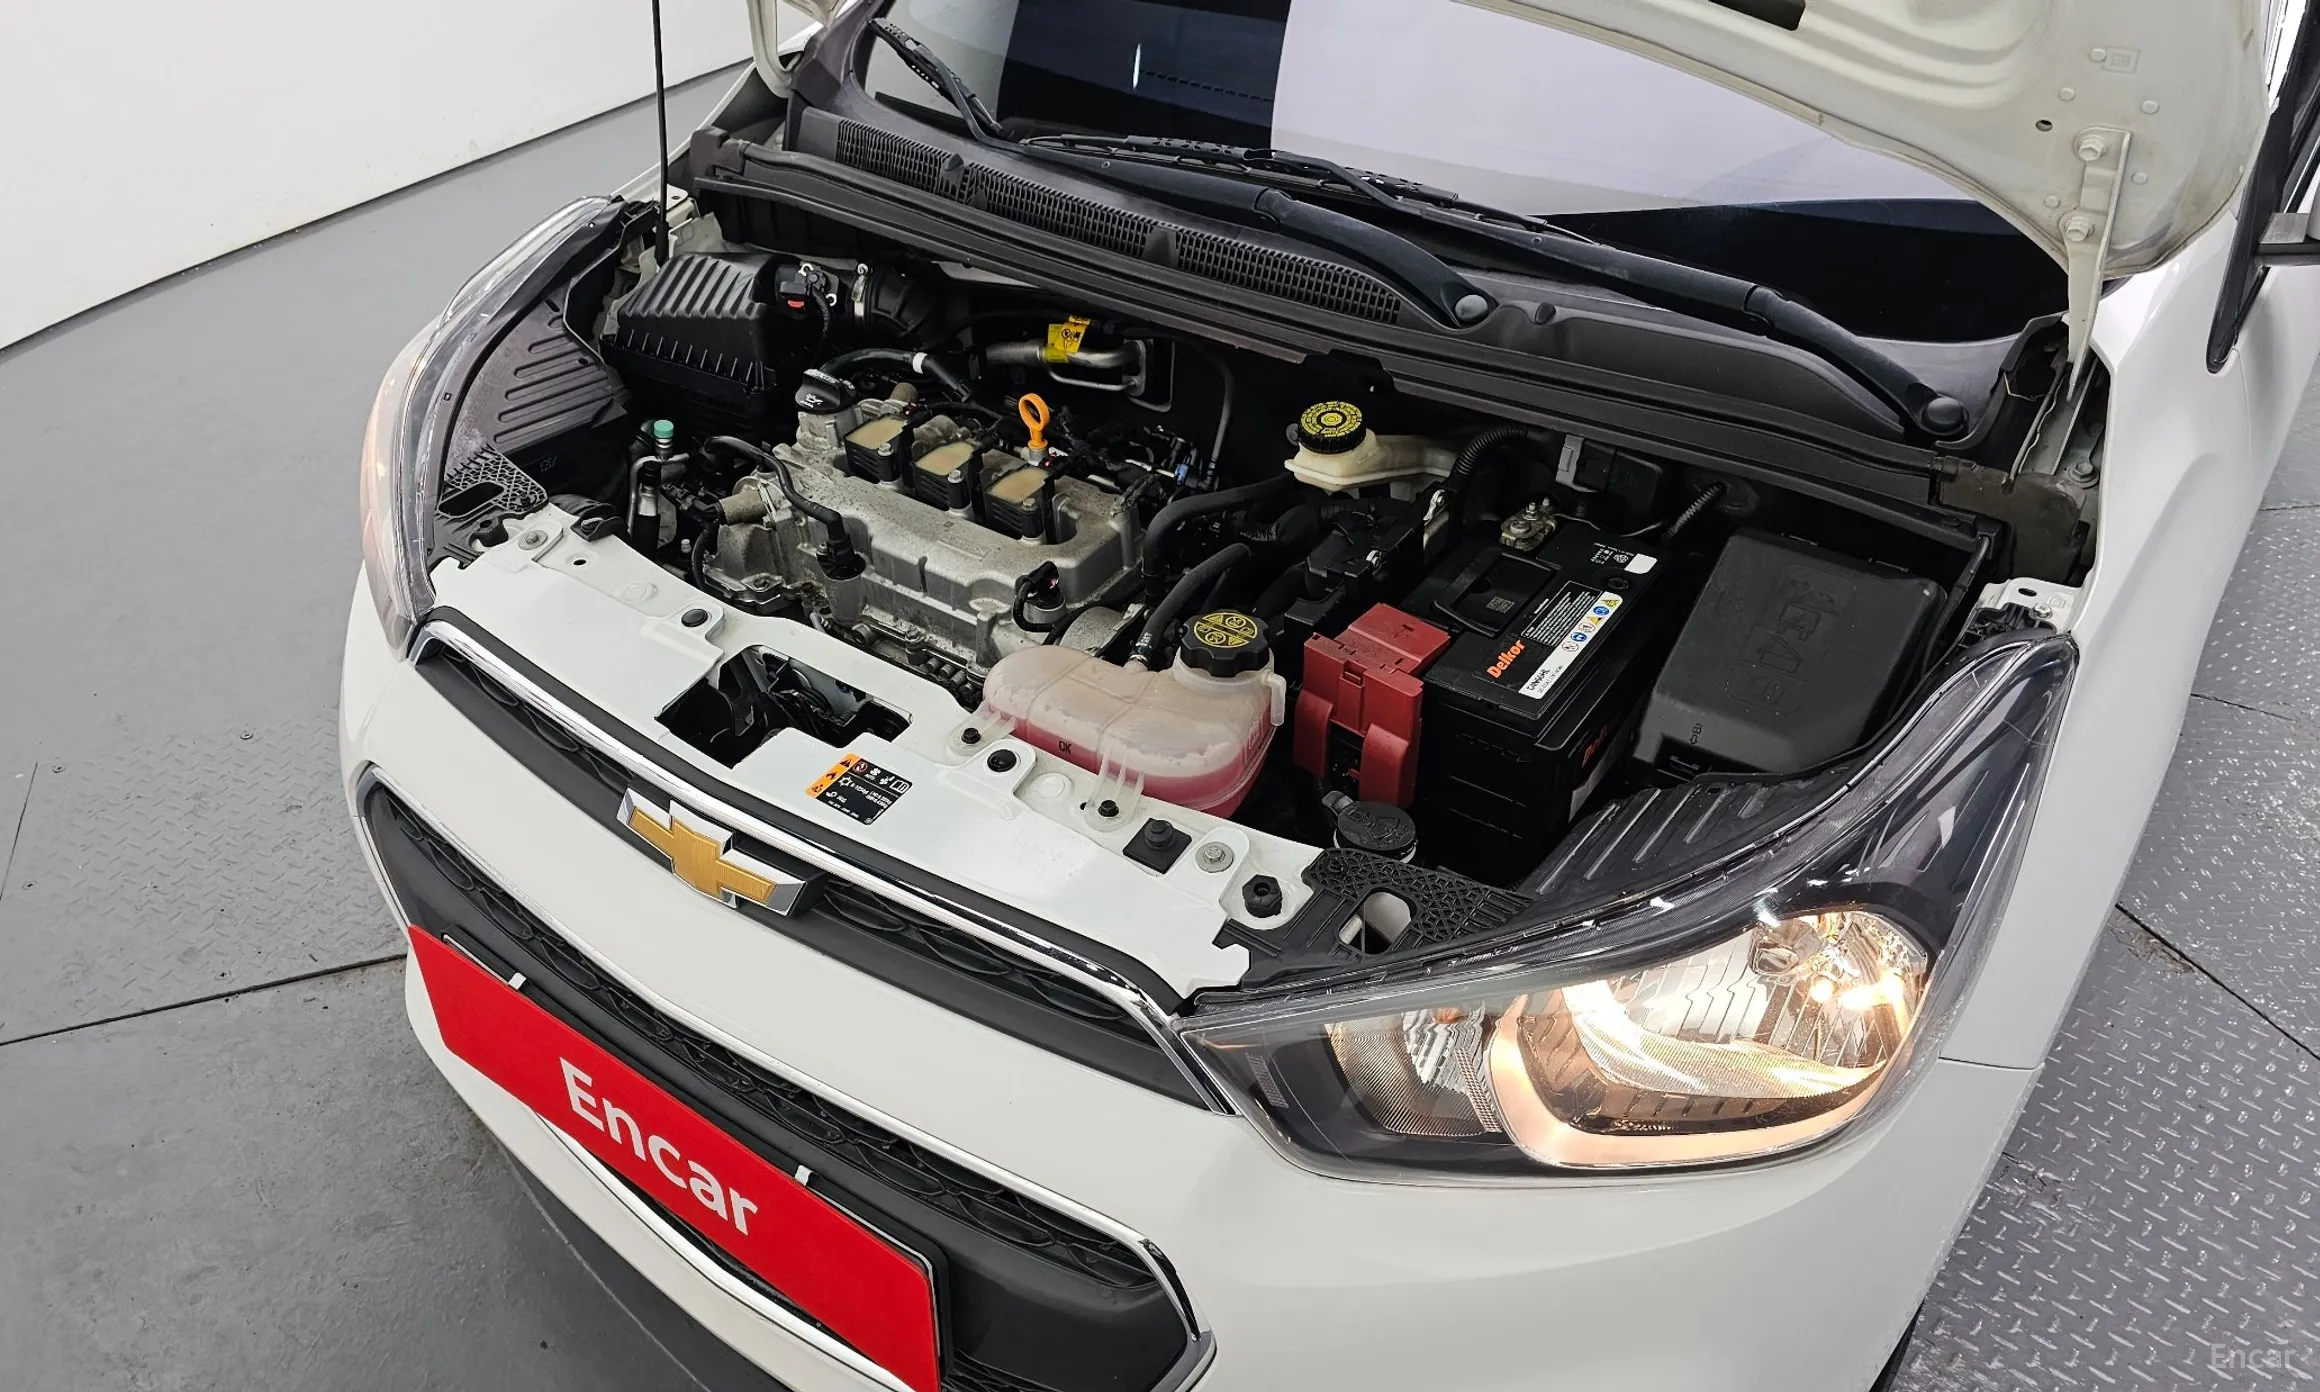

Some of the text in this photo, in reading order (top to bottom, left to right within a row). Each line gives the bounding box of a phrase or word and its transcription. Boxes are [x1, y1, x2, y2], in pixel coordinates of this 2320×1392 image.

[1486, 639, 1525, 678] Delkor
[1059, 740, 1072, 754] OK
[560, 1056, 758, 1236] Encar
